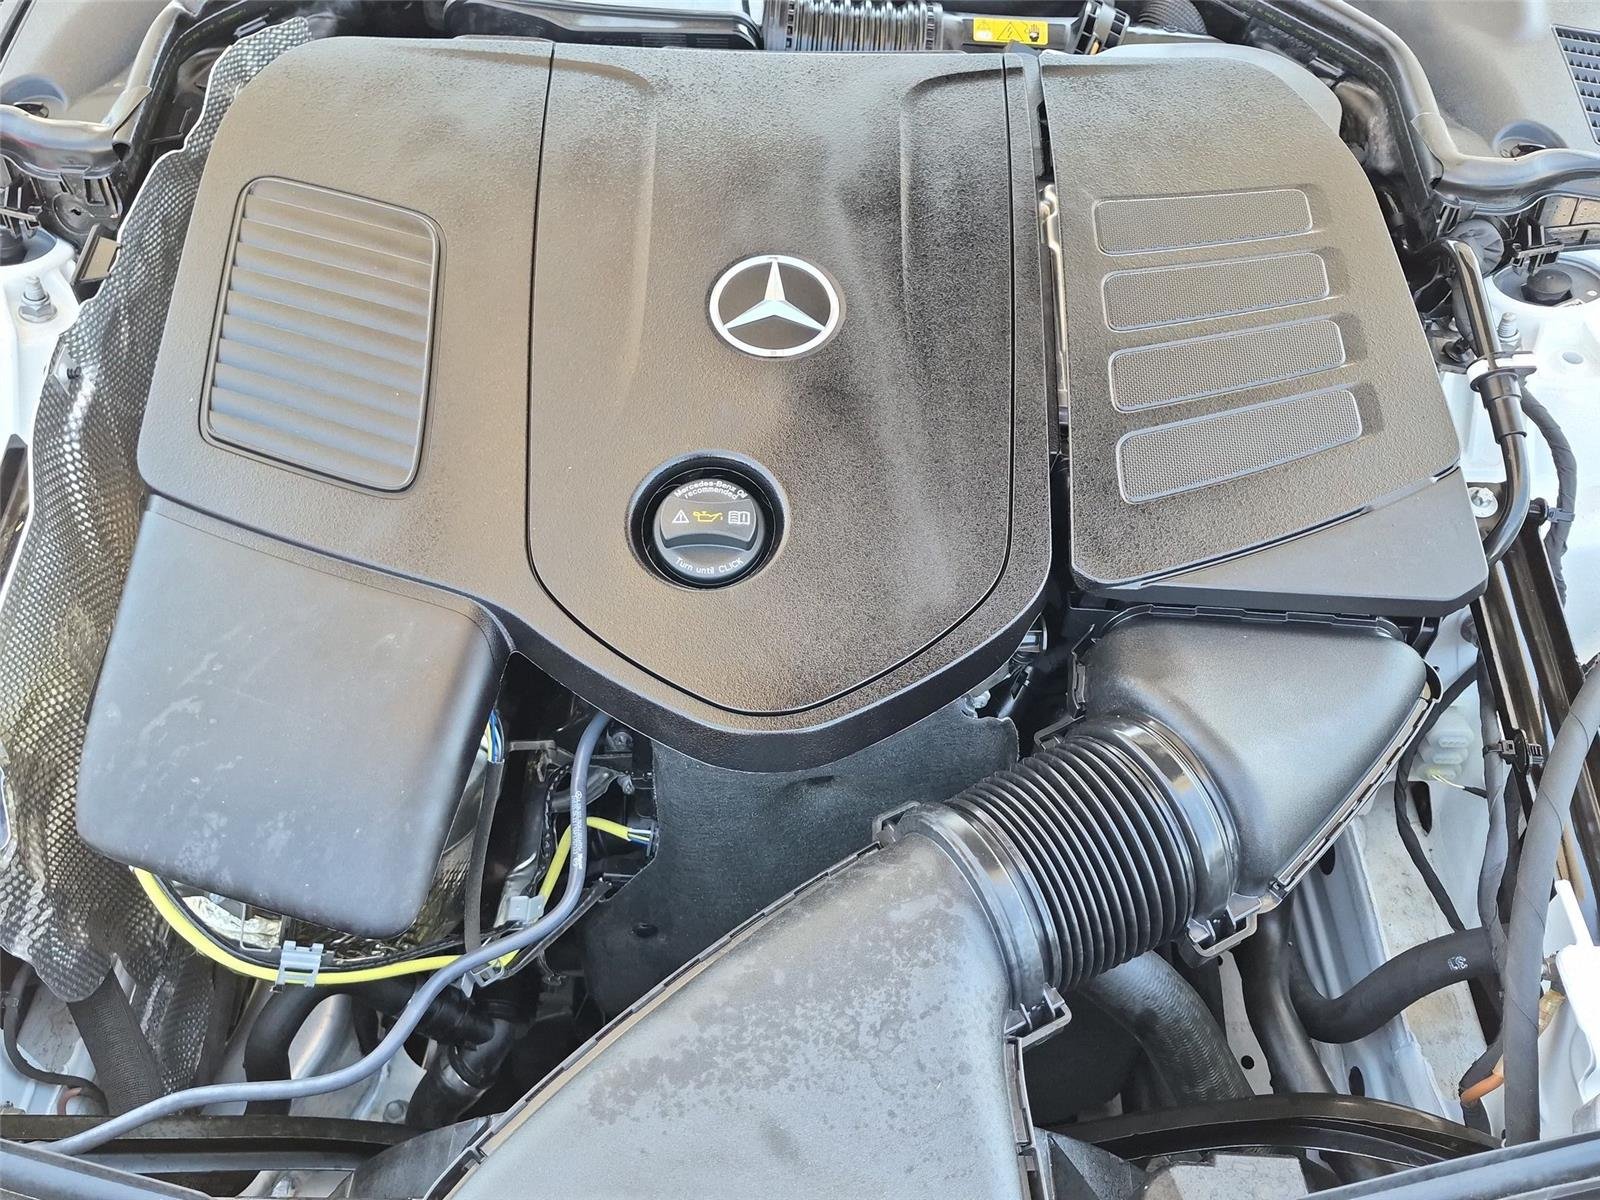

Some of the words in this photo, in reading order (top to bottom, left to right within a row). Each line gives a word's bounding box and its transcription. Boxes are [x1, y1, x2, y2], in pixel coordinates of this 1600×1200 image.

[674, 480, 736, 498] Mercedes-Benz
[684, 486, 738, 500] recommended
[676, 557, 693, 572] Turn
[696, 566, 714, 575] until
[718, 557, 744, 573] CLICK
